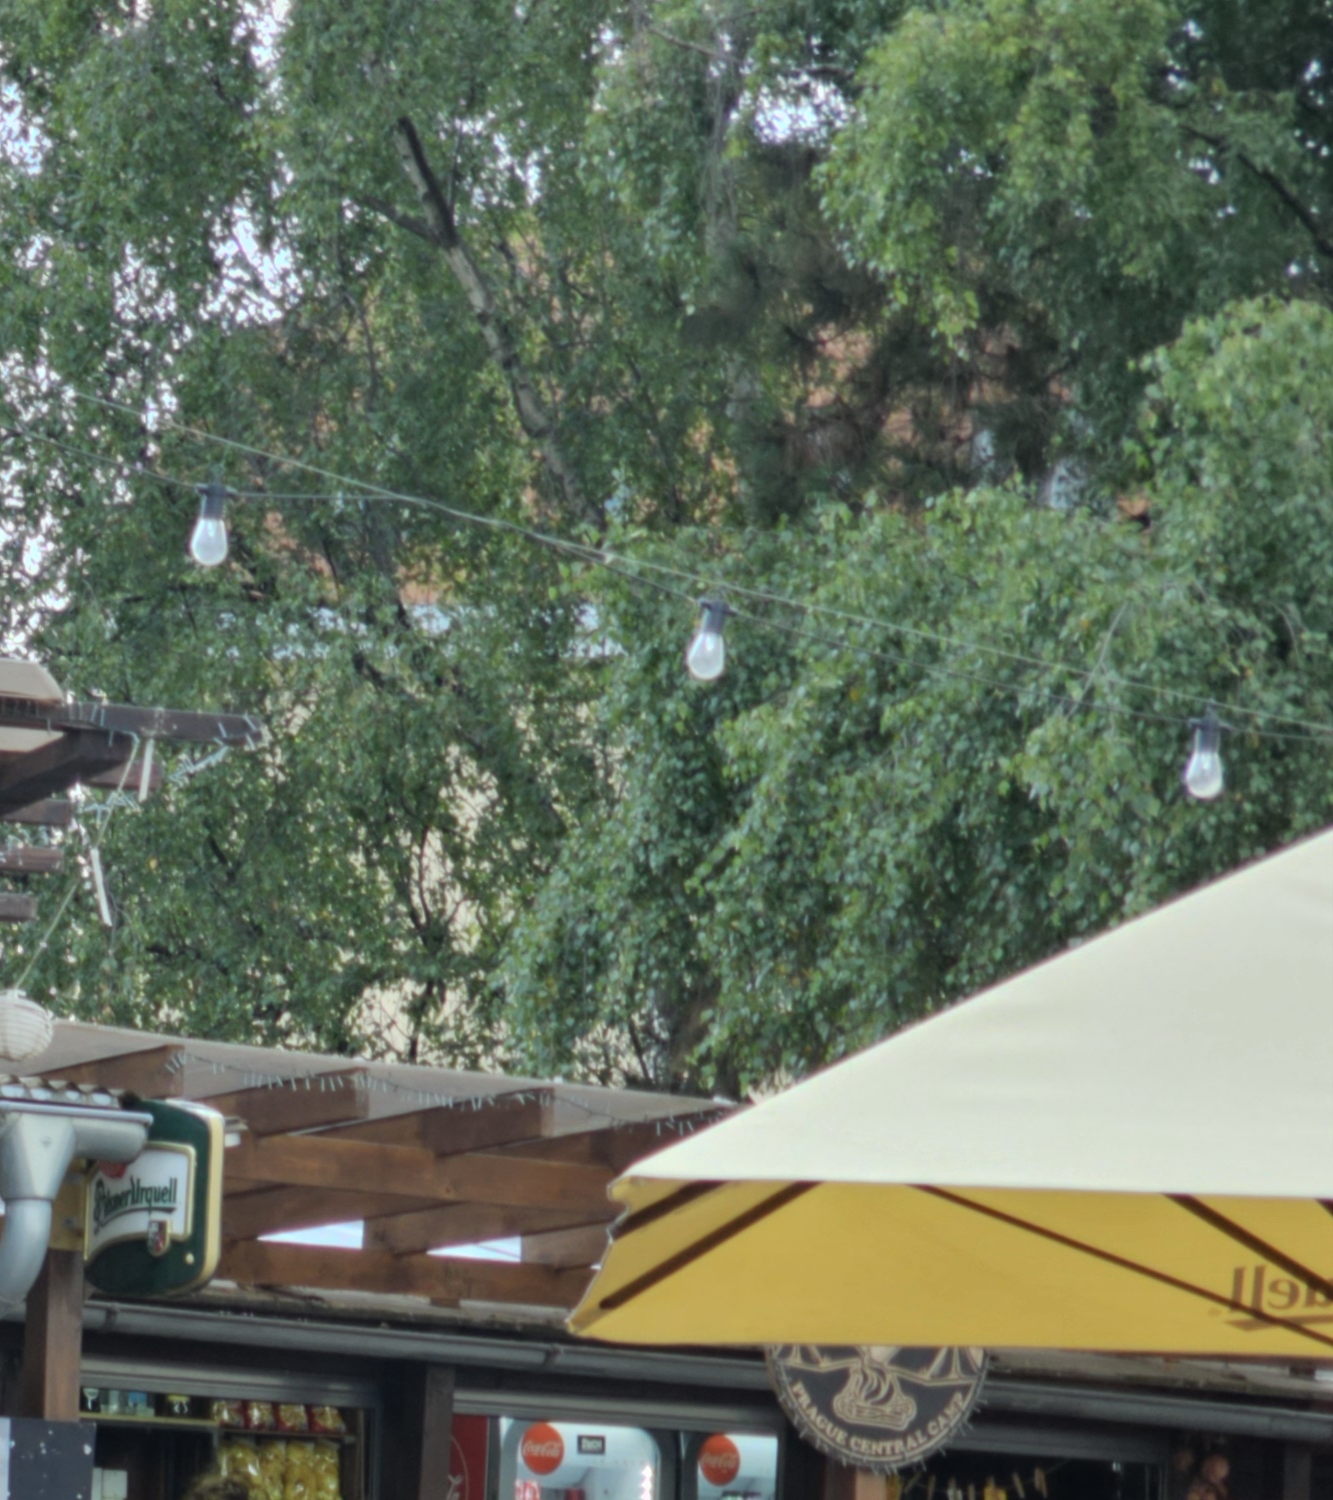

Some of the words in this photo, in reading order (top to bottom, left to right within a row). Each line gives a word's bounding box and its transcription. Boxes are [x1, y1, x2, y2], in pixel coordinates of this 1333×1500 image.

[129, 1174, 178, 1217] Urquell
[792, 1380, 849, 1443] PRAGUE
[849, 1428, 928, 1456] CENTRAL
